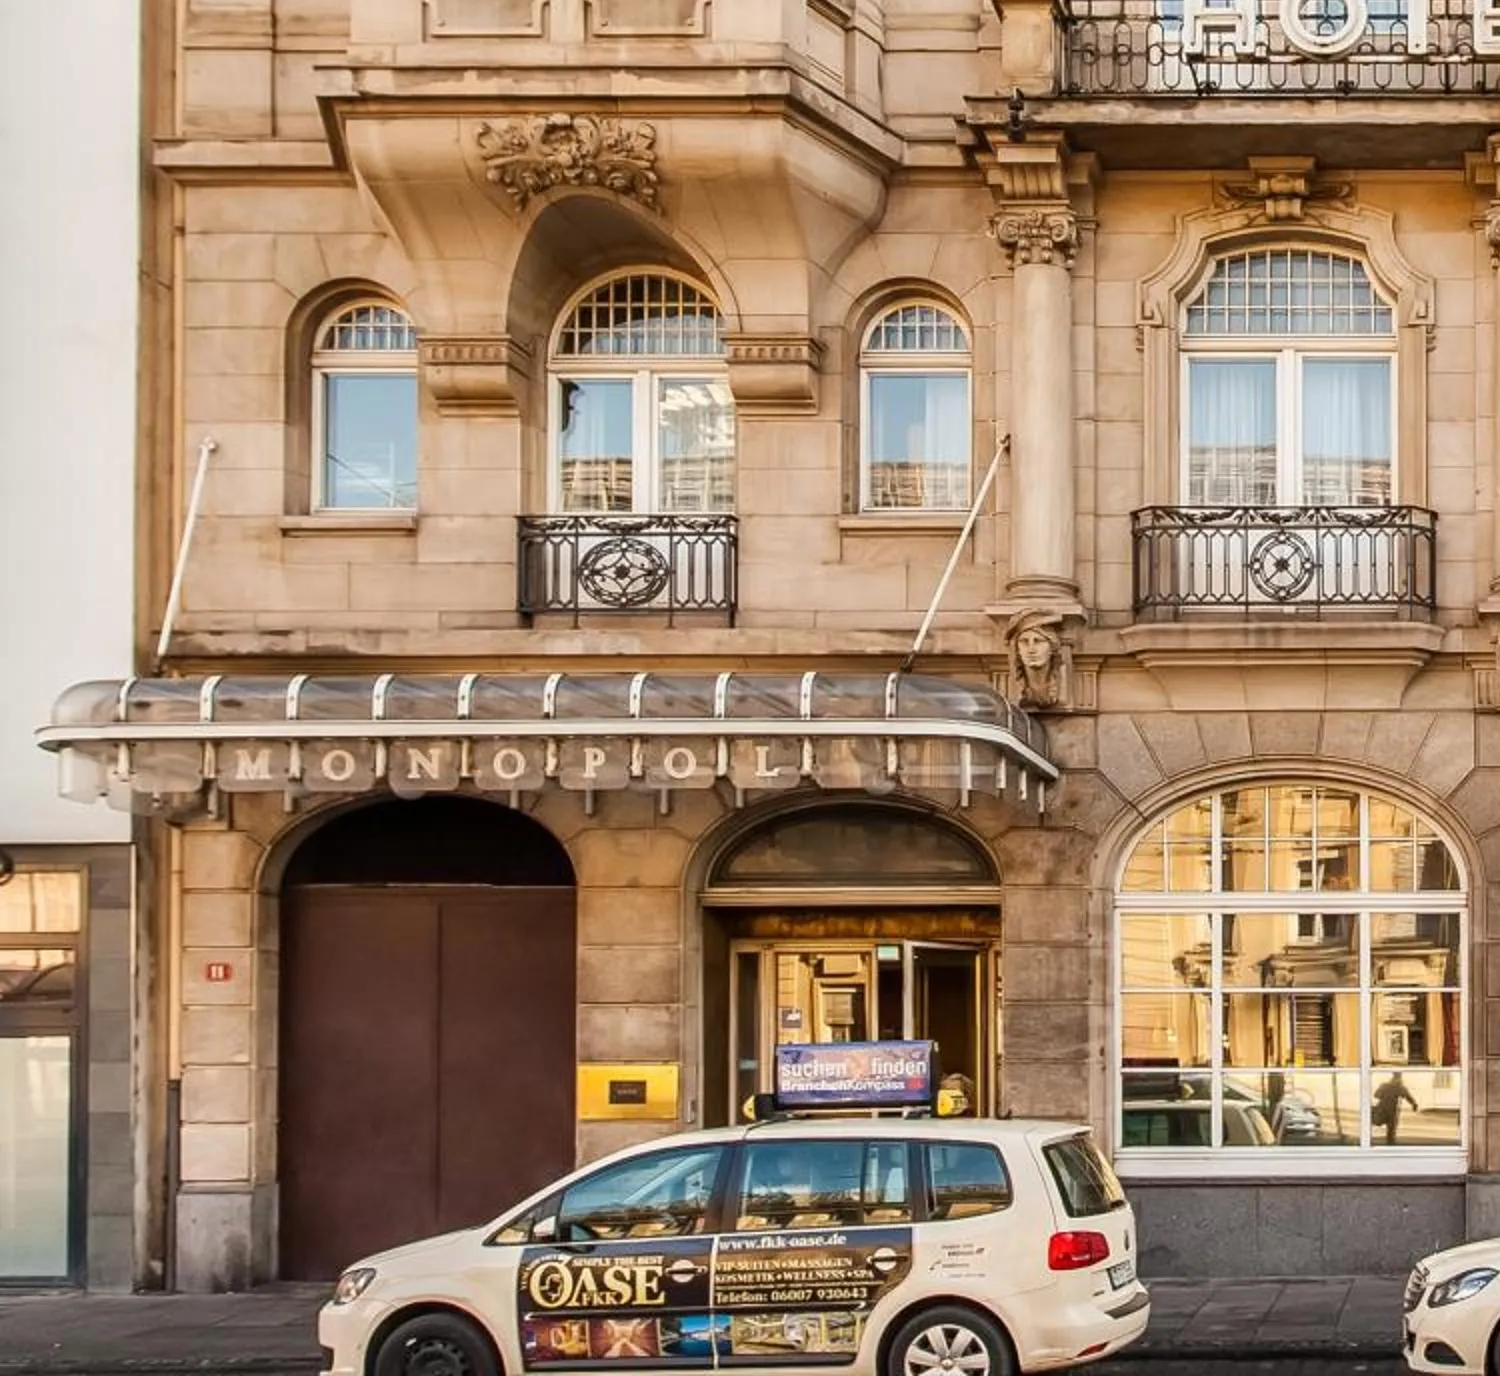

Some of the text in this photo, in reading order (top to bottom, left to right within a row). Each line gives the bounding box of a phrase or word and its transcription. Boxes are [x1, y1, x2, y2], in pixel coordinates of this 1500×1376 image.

[234, 747, 781, 781] MONOPOL
[781, 1057, 927, 1077] suchen finden
[718, 1233, 848, 1251] www.fkk-oase.de
[715, 1271, 775, 1284] KOSMETIK
[782, 1270, 847, 1282] WELLNESS
[582, 1292, 618, 1306] FKK
[715, 1287, 868, 1304] Telefon: 06007 930643
